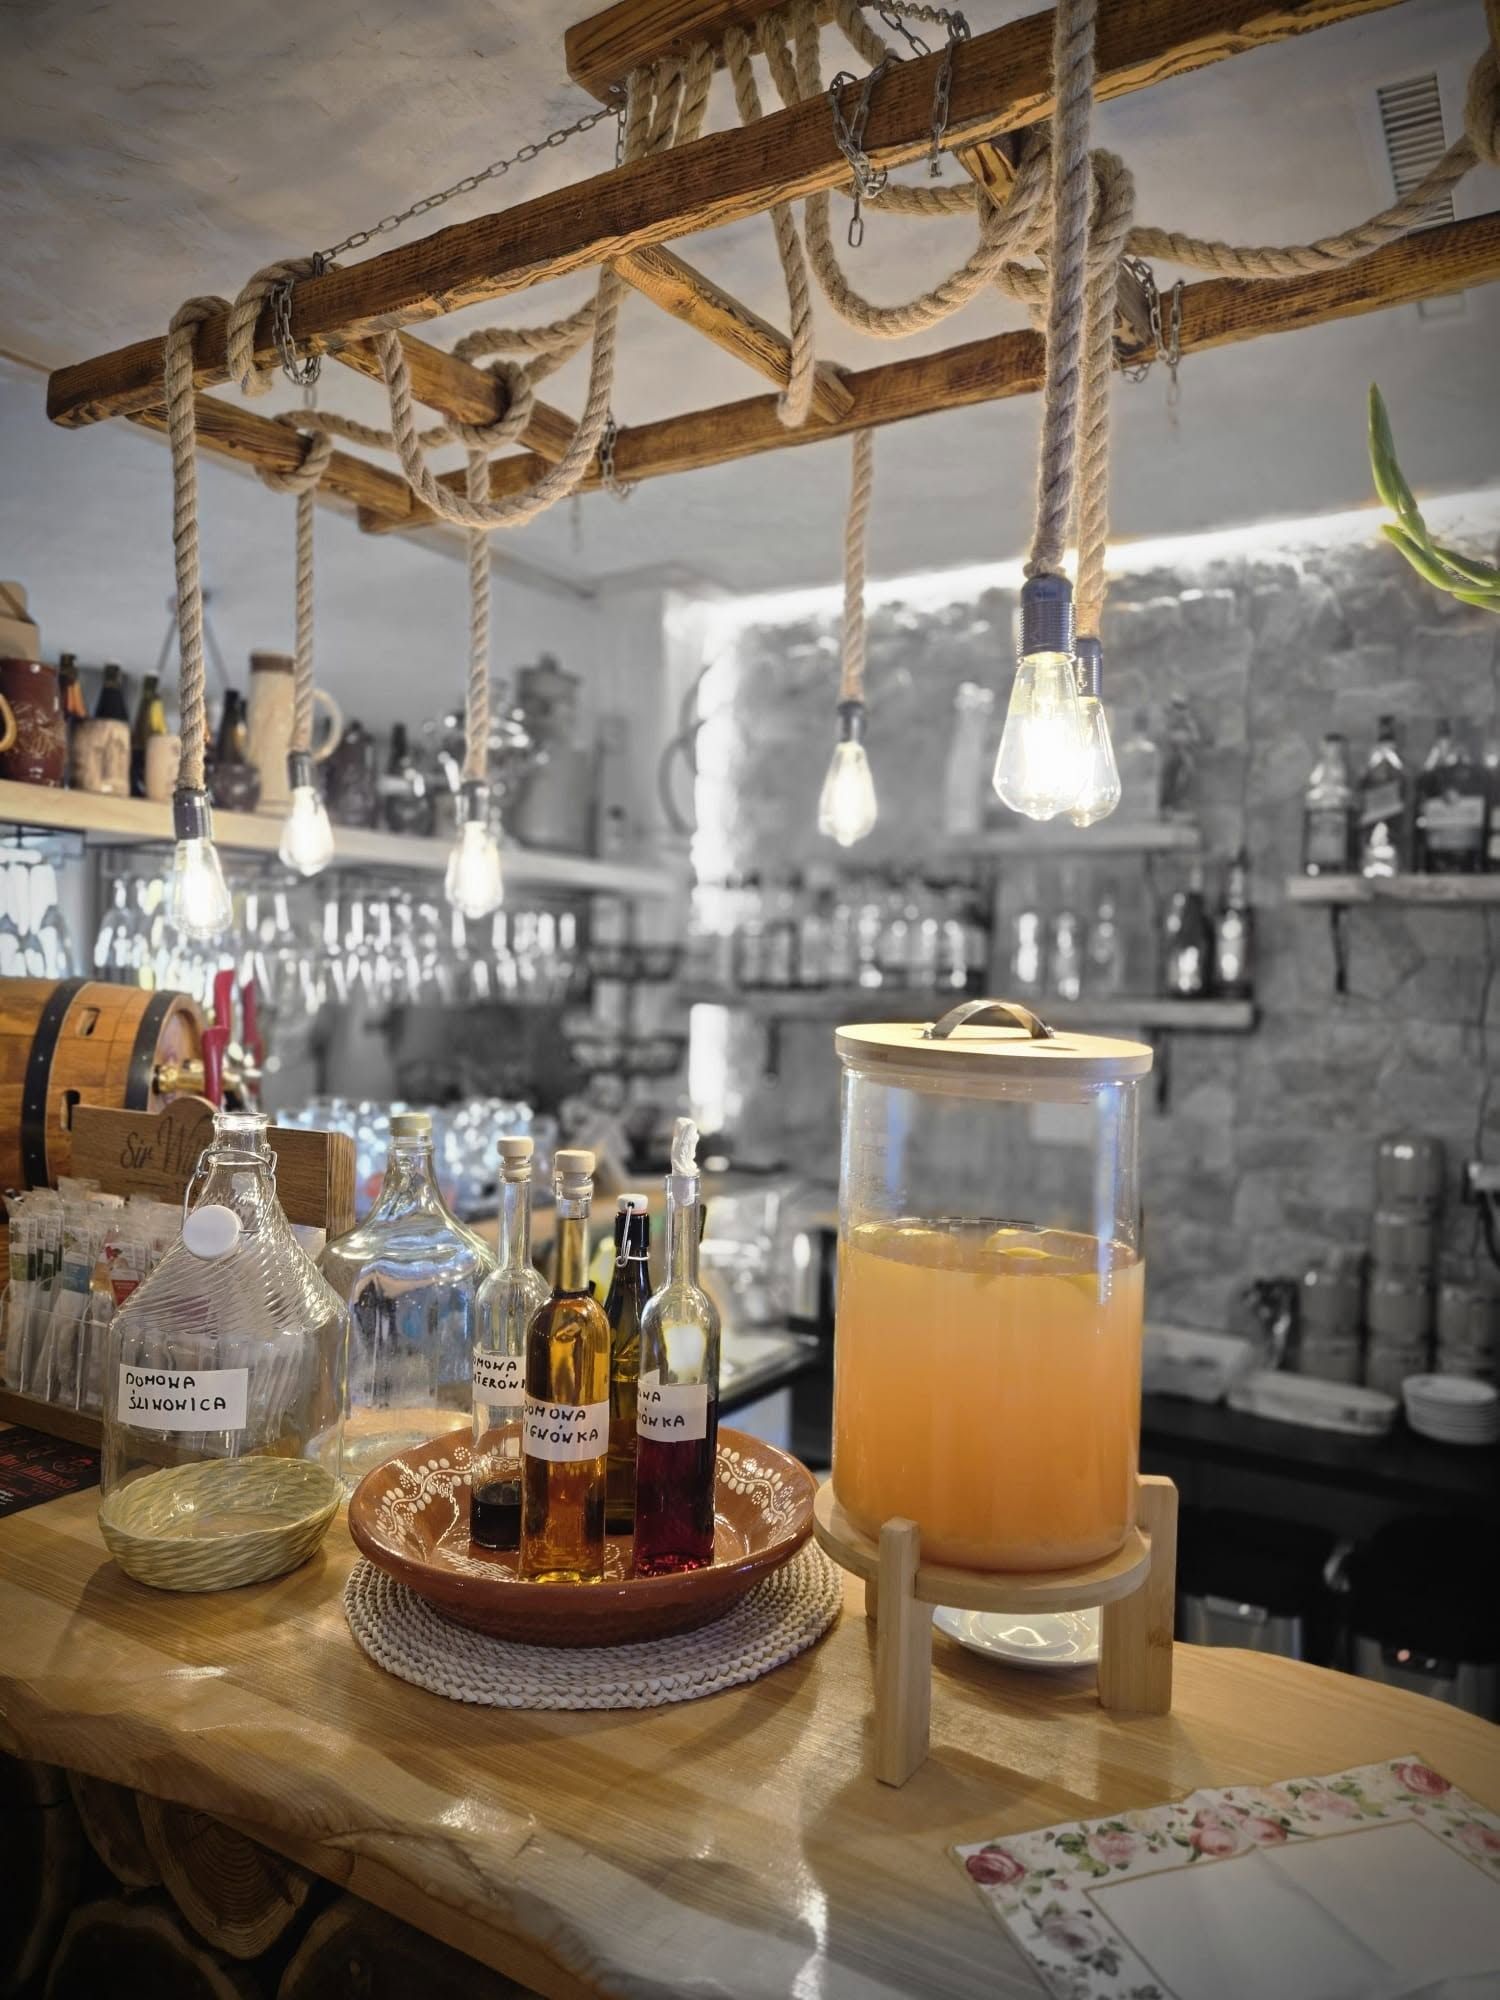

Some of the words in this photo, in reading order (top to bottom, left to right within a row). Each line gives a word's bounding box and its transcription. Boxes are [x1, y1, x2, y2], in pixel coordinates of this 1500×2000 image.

[120, 1131, 153, 1169] Sir
[125, 1372, 196, 1389] DOMOWA
[128, 1389, 226, 1412] ŚLIWOWICA
[640, 1407, 685, 1428] ÓWKA
